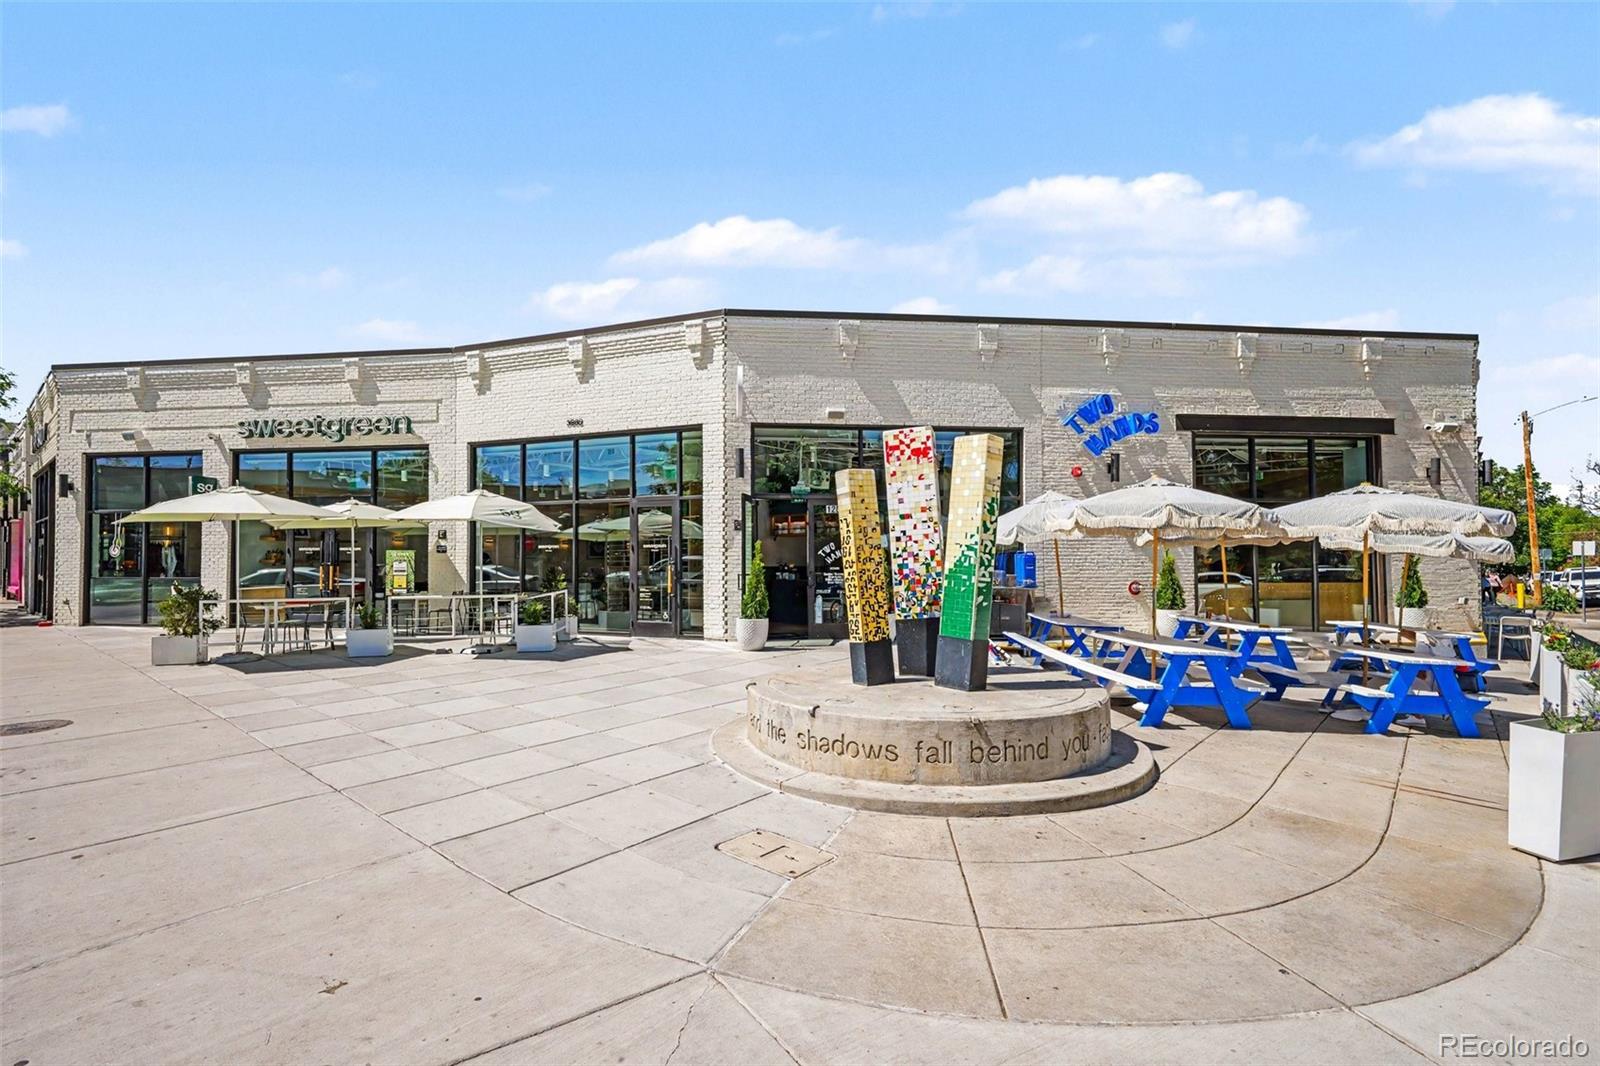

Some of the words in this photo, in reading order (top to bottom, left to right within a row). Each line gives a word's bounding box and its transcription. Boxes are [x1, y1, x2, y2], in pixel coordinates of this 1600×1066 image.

[236, 415, 414, 442] sweetgreen
[1061, 393, 1114, 435] TWO
[1083, 412, 1160, 457] HANDS
[817, 542, 836, 557] TWO
[767, 718, 787, 745] the
[797, 729, 899, 763] shadows
[915, 740, 952, 764] fall
[970, 735, 1049, 764] behind
[1062, 733, 1090, 761] you
